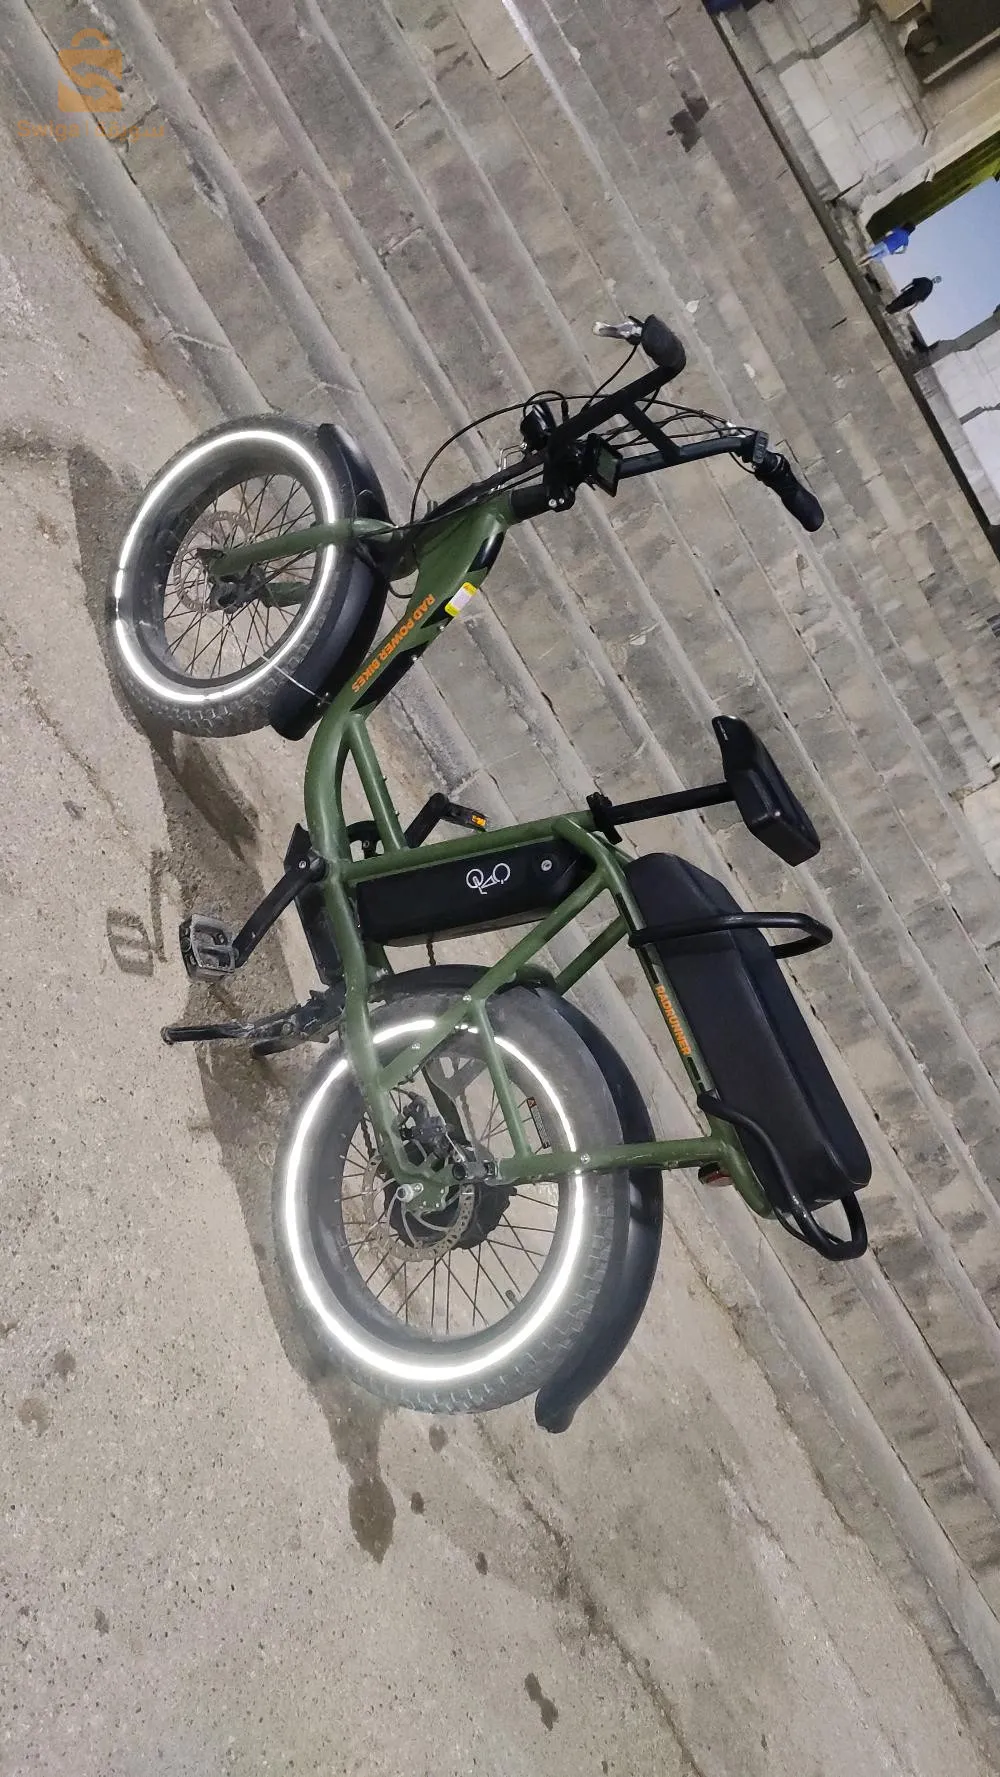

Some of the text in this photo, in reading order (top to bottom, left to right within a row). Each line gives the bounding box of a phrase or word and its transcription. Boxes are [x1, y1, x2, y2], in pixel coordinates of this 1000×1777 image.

[351, 593, 436, 693] RAD POWER BIKES
[655, 984, 692, 1056] RADRUNNER
